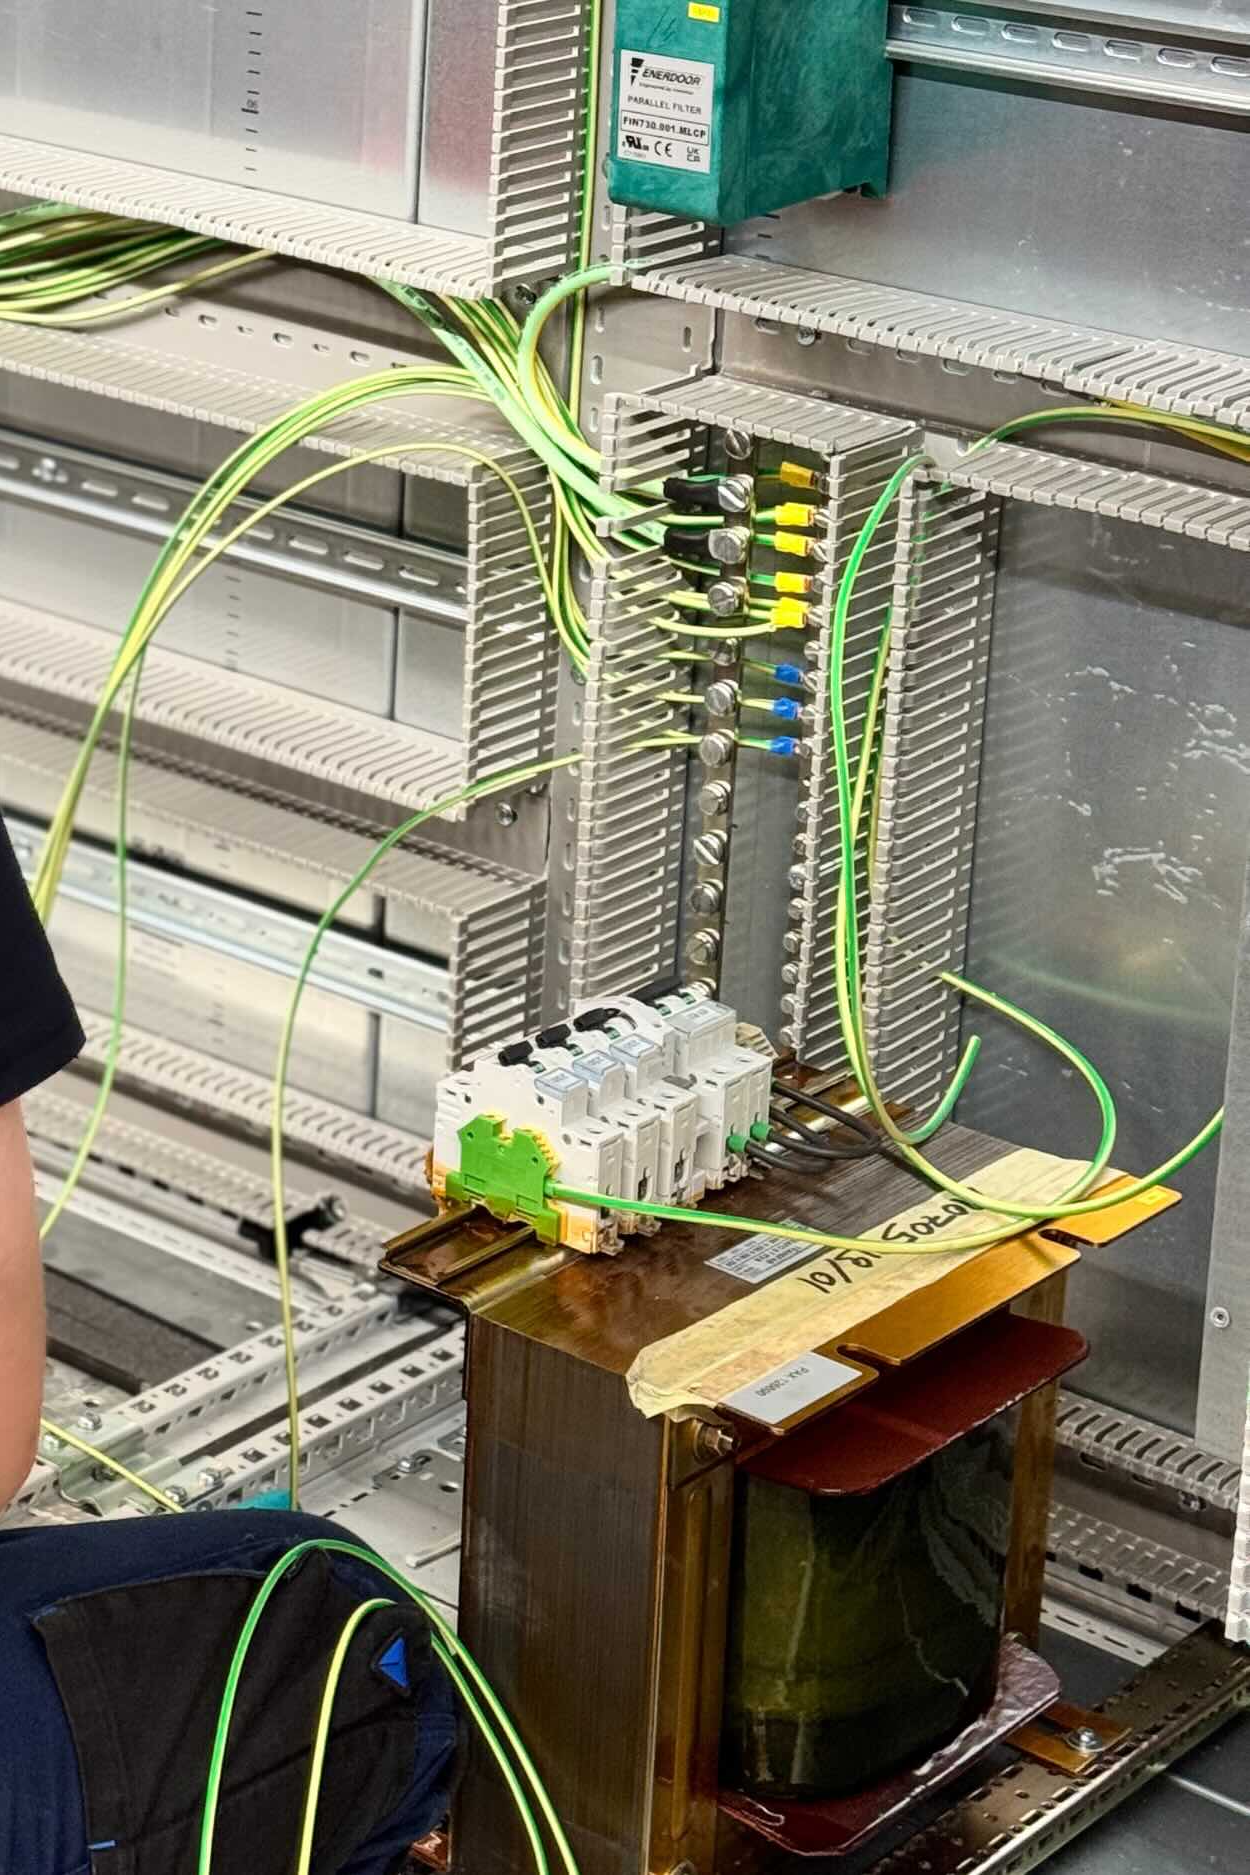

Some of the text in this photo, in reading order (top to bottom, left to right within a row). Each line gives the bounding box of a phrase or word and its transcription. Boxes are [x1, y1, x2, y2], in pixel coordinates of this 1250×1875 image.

[642, 68, 701, 86] ENERDOOR
[627, 95, 702, 115] PARALLEL FILTER
